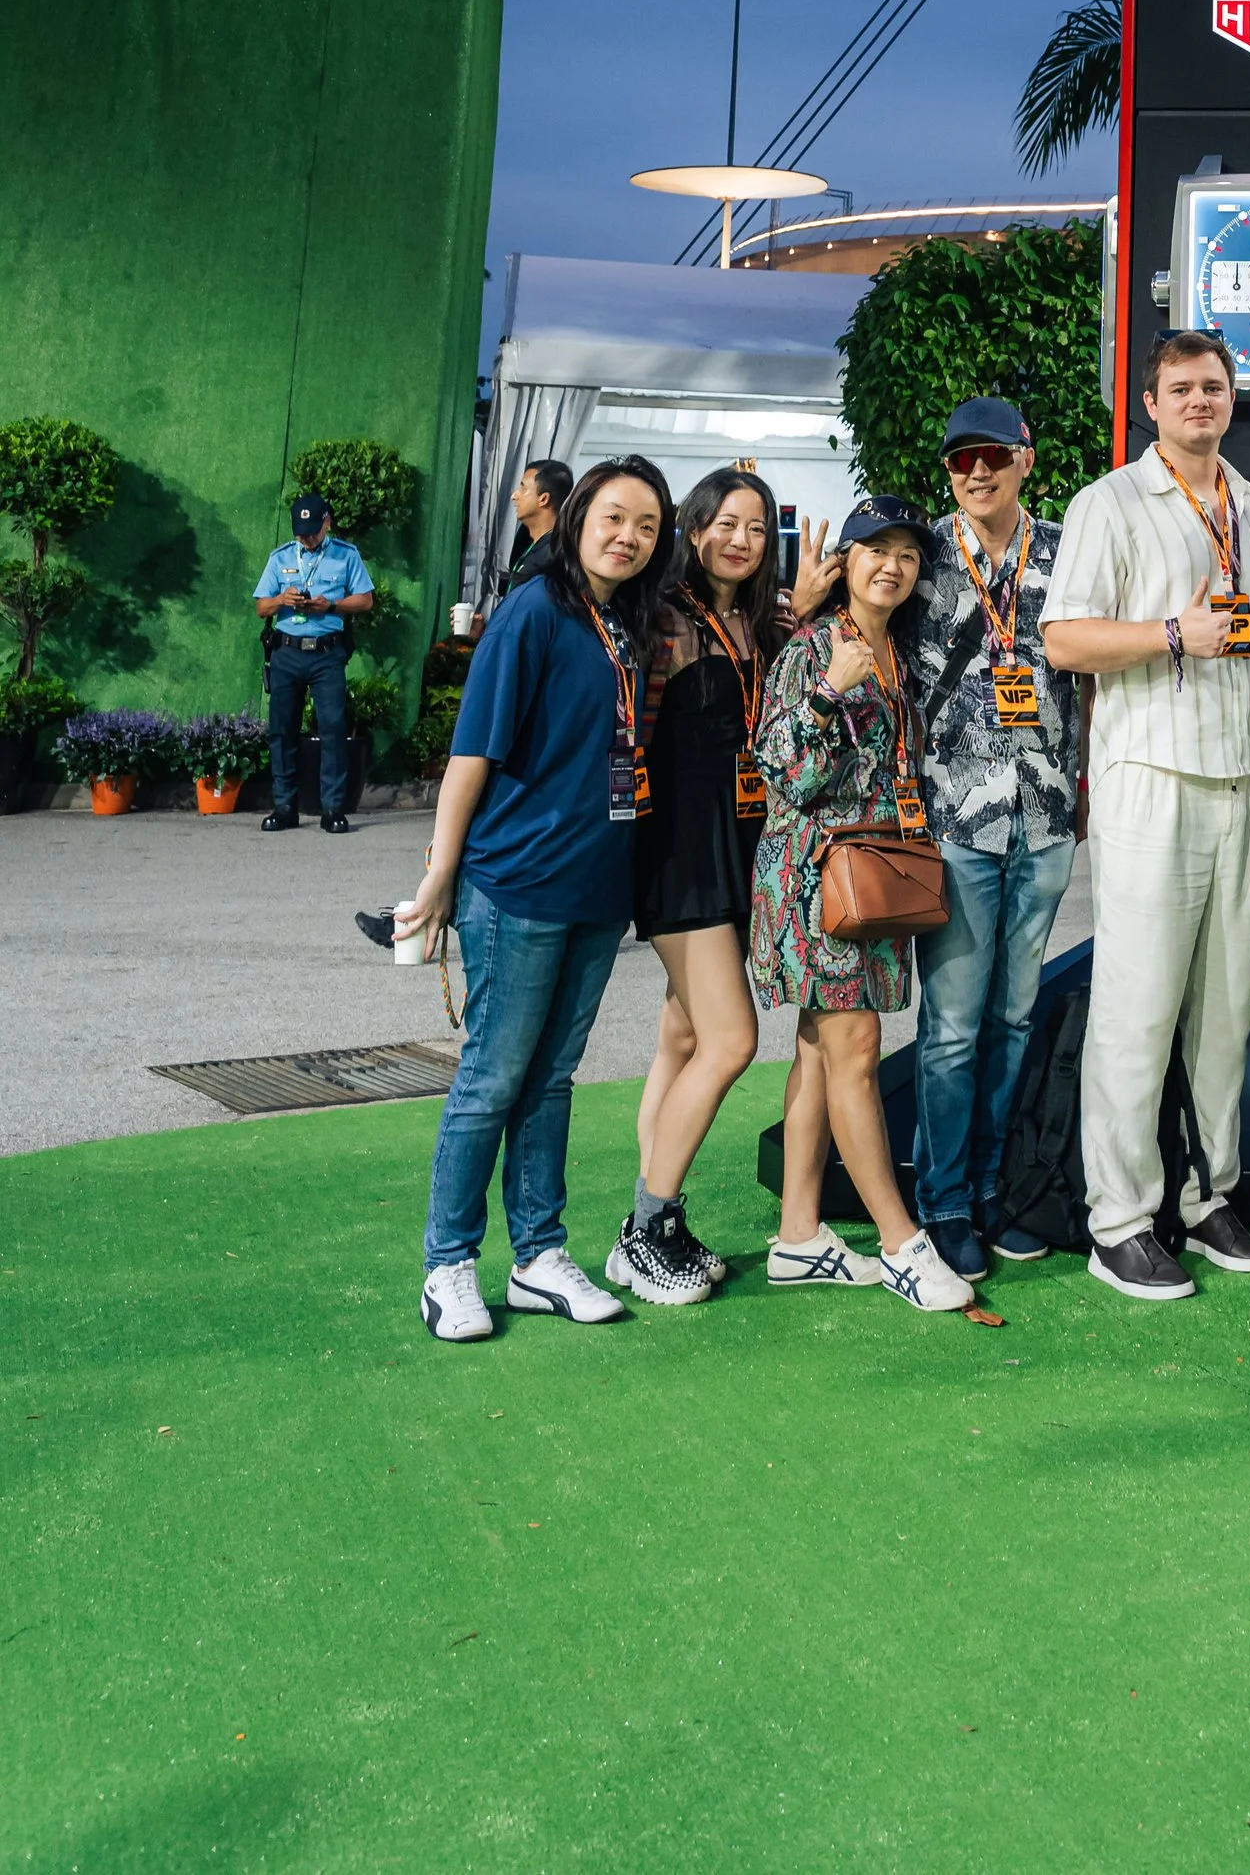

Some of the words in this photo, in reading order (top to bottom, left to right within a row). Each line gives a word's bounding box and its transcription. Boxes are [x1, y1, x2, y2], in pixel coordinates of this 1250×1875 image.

[1230, 618, 1249, 634] IP
[999, 689, 1033, 704] VIP
[739, 776, 764, 794] VIP
[900, 802, 920, 819] VIP
